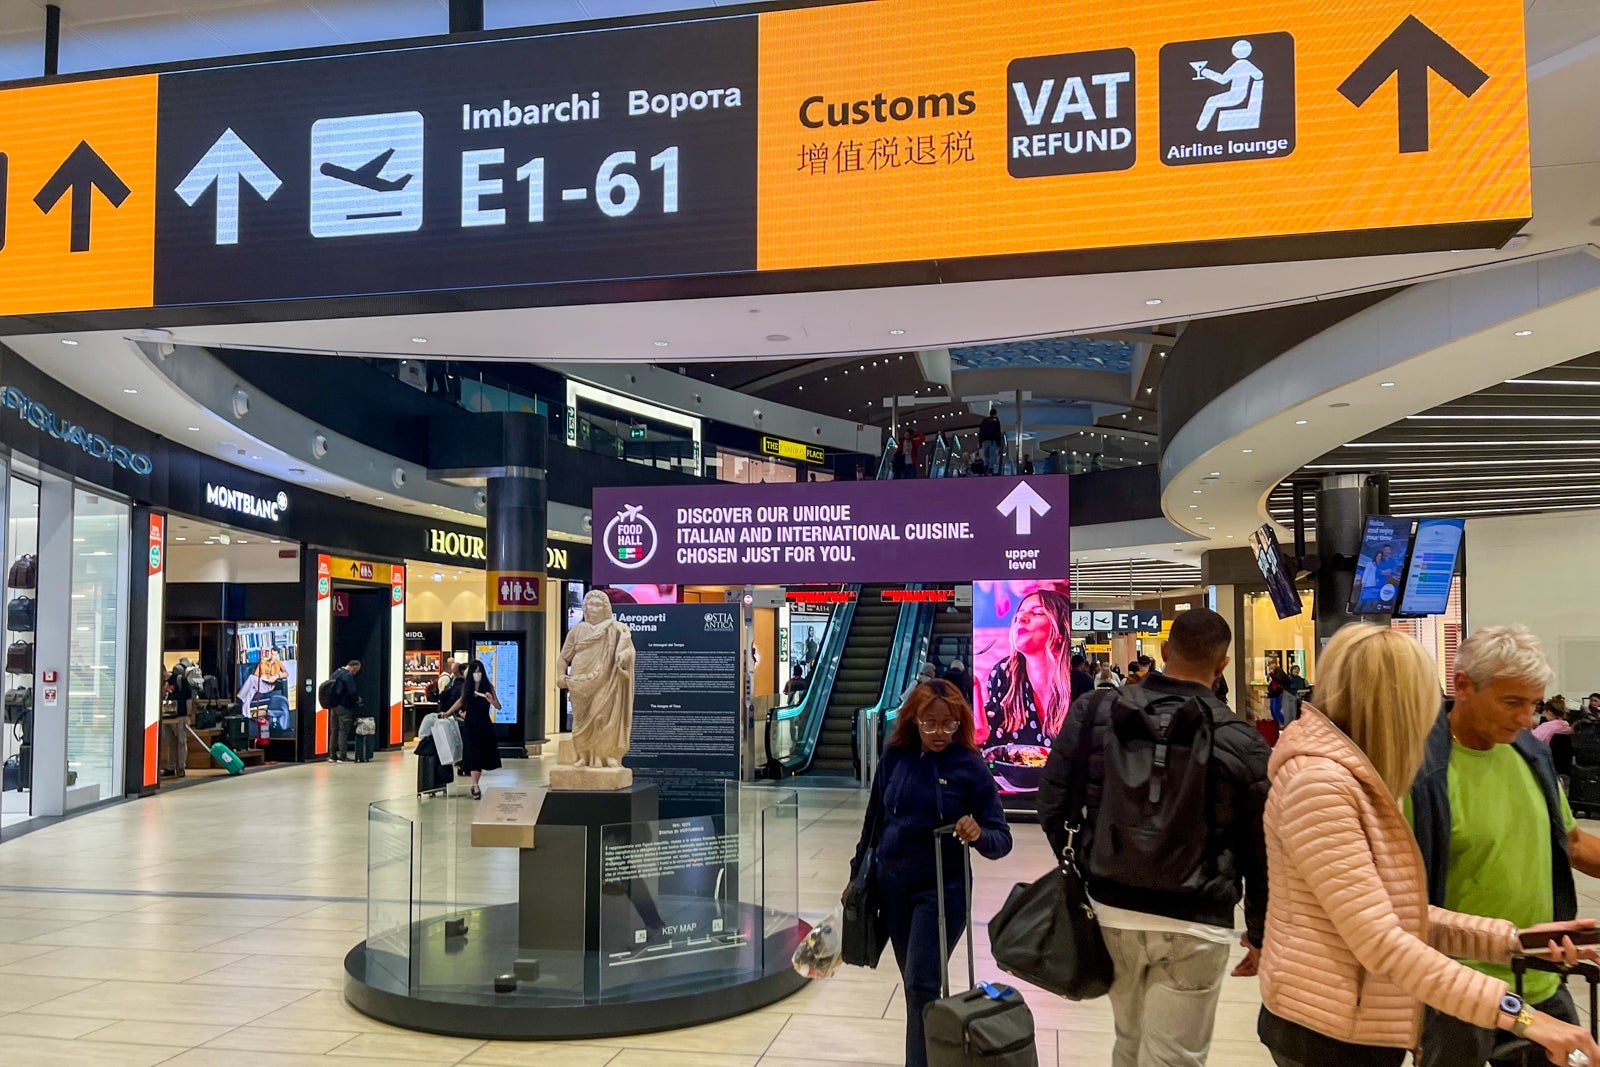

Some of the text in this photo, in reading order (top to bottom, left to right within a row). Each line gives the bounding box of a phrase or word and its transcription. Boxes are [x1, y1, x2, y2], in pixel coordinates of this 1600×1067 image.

[628, 86, 742, 119] Ворота
[799, 87, 977, 130] Customs
[1011, 71, 1131, 127] VAT
[462, 91, 600, 131] Imbarchi
[796, 130, 976, 176] 增值税退税
[1012, 126, 1132, 159] REFUND
[1167, 135, 1289, 160] Airline lounge
[461, 145, 680, 228] E1-61
[766, 440, 779, 451] THE
[806, 449, 823, 460] PLACE
[206, 483, 279, 520] MONTBLANC
[676, 504, 851, 525] DISCOVER OUR UNIQUE
[617, 524, 643, 536] FOOD
[617, 535, 643, 546] HALL
[676, 522, 974, 544] ITALIAN AND INTERNATIONAL CUISINE.
[430, 528, 487, 560] HOUR
[676, 545, 856, 564] CHOSEN JUST FOR YOU.
[1005, 549, 1040, 561] upper
[1008, 559, 1036, 570] level
[619, 613, 666, 624] Aeroporti
[629, 623, 657, 632] Roma
[704, 622, 734, 630] ANTICA
[662, 922, 697, 936] KEY MAP
